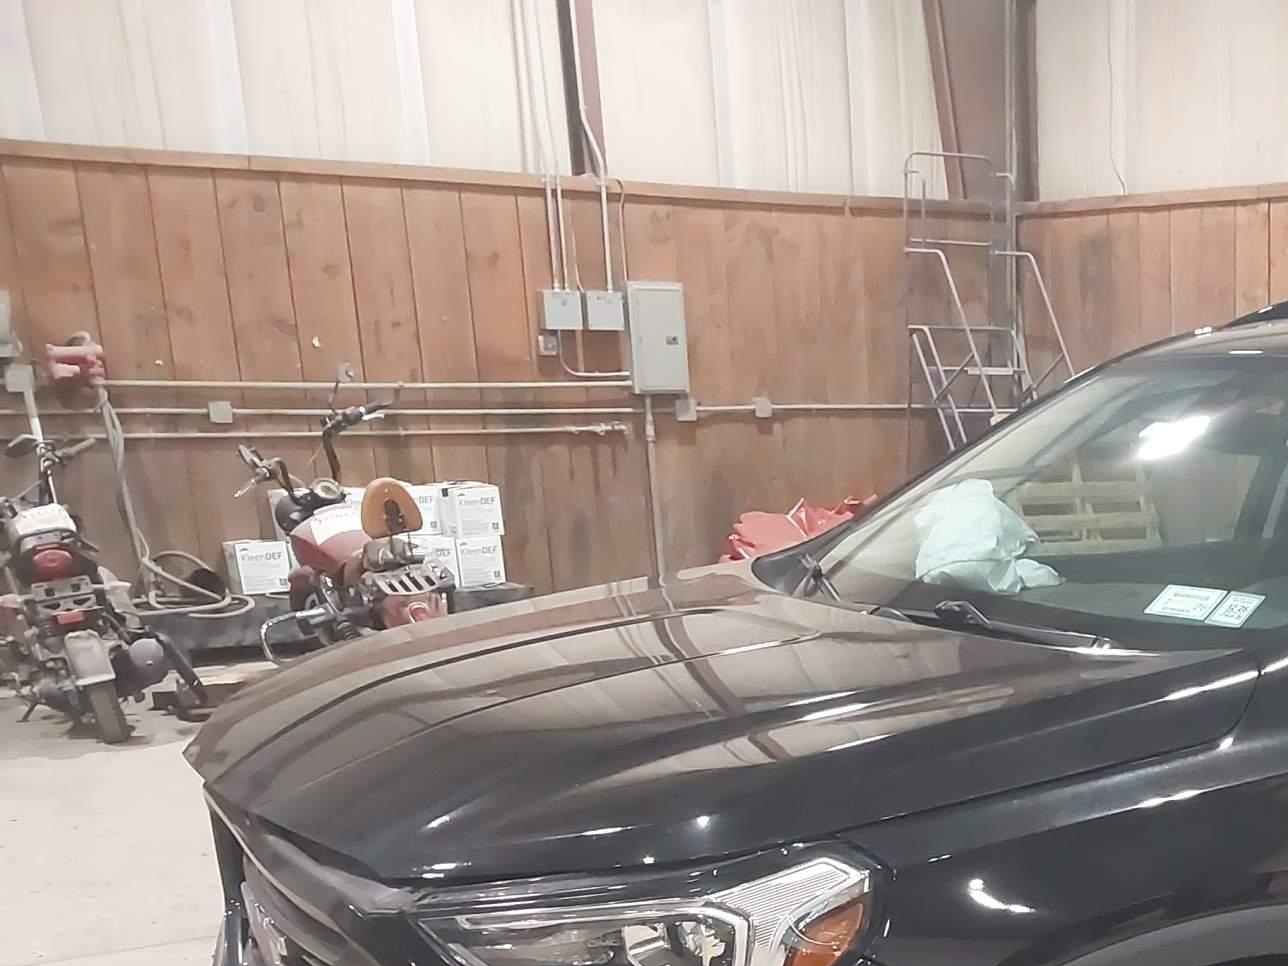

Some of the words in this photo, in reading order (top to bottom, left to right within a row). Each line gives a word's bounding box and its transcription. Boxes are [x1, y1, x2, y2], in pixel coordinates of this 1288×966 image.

[459, 496, 496, 506] KleenDEF
[460, 545, 497, 555] KleenDEF
[241, 551, 283, 562] KleenDEF
